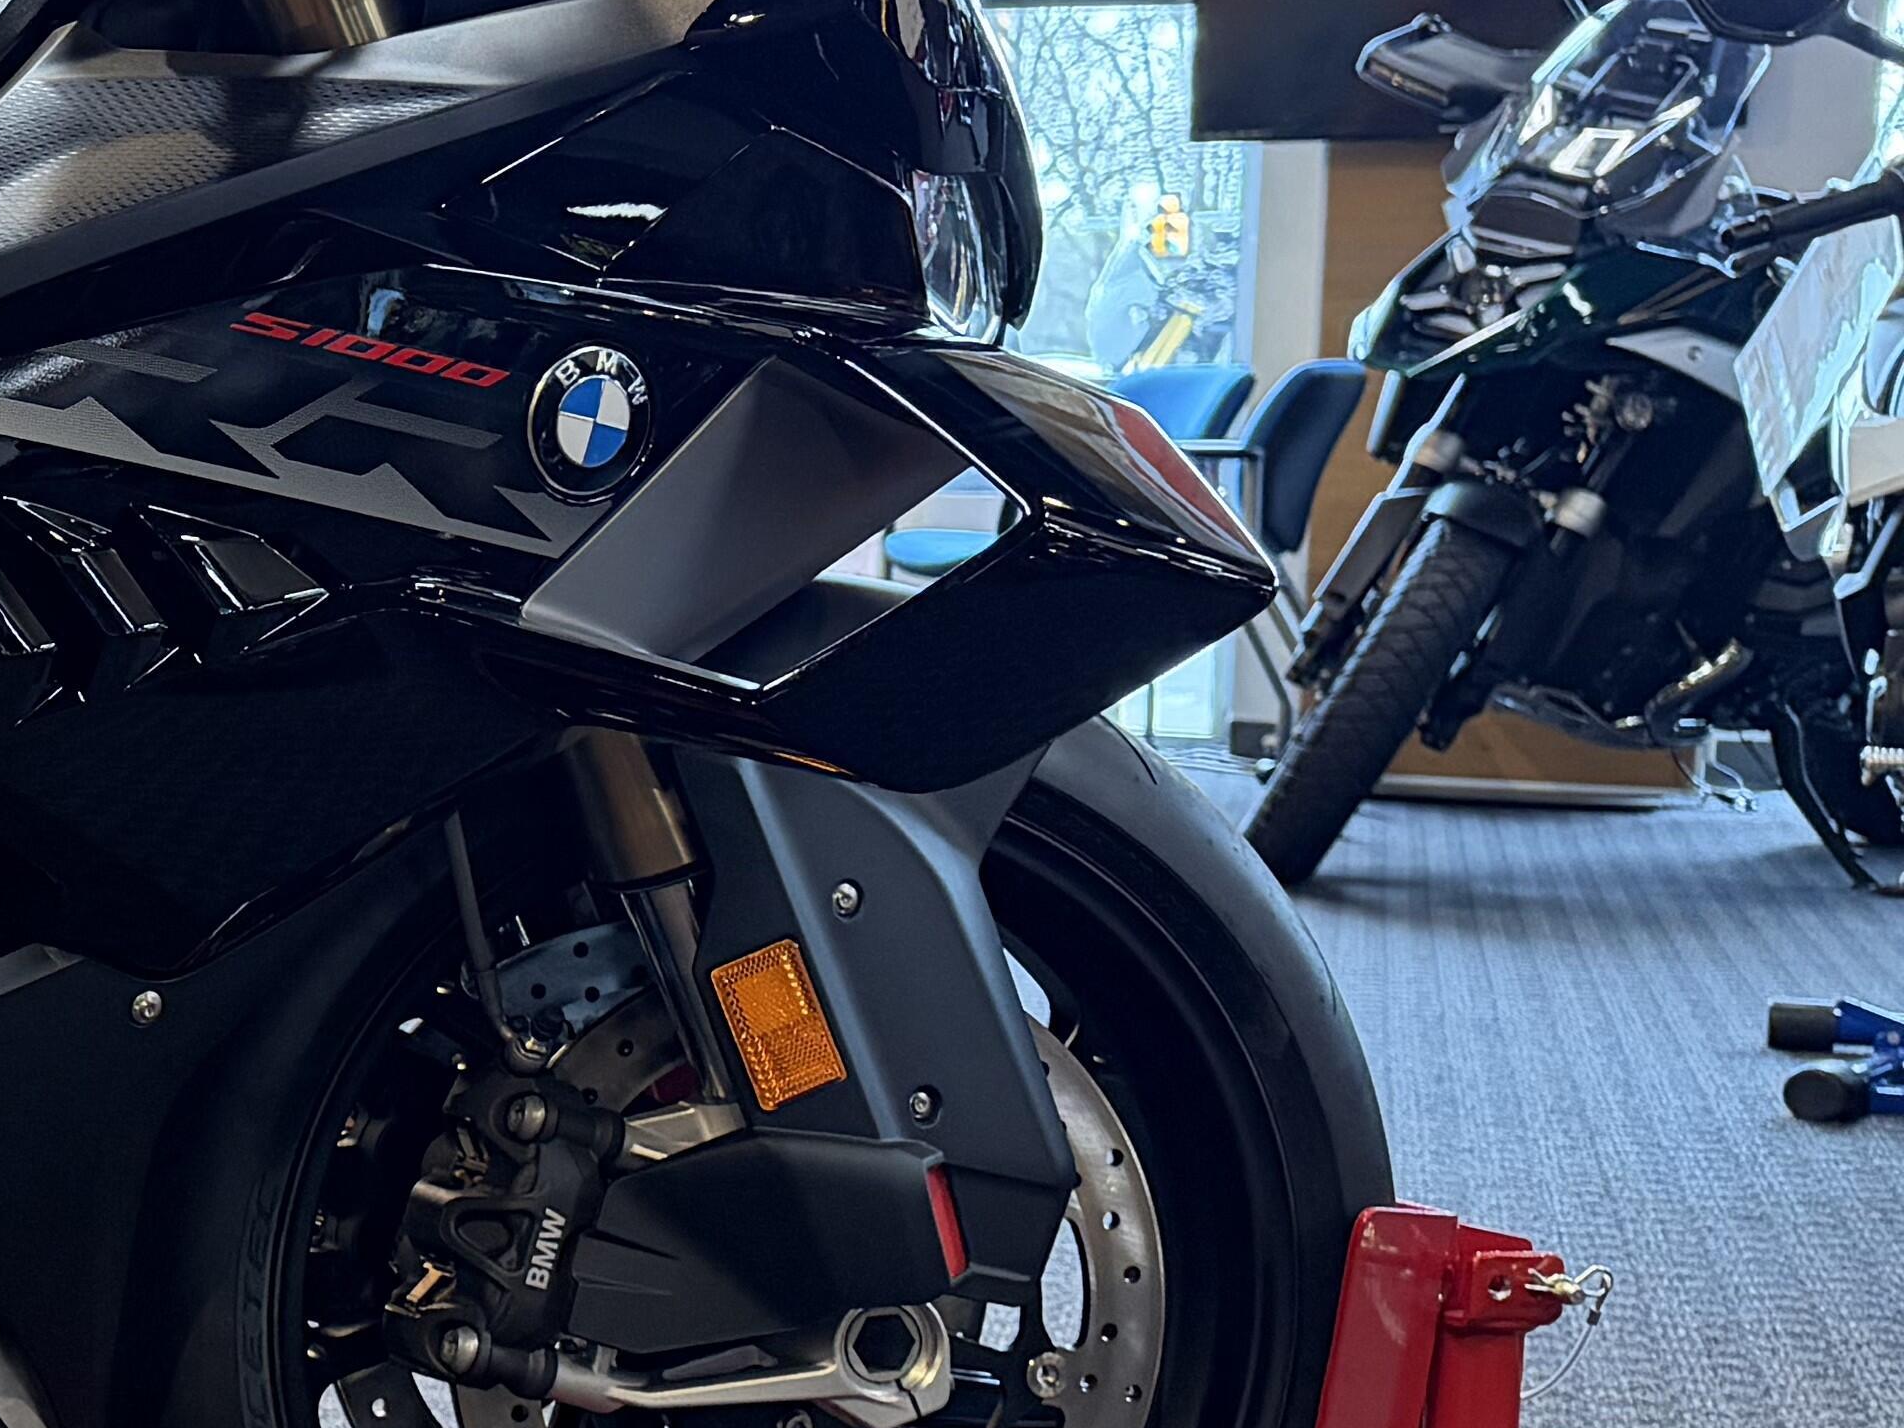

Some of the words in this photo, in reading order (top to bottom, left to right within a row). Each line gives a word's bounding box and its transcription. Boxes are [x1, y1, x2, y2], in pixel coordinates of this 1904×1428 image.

[229, 312, 511, 388] S1000
[554, 349, 649, 406] BMW
[525, 1207, 566, 1290] BMW
